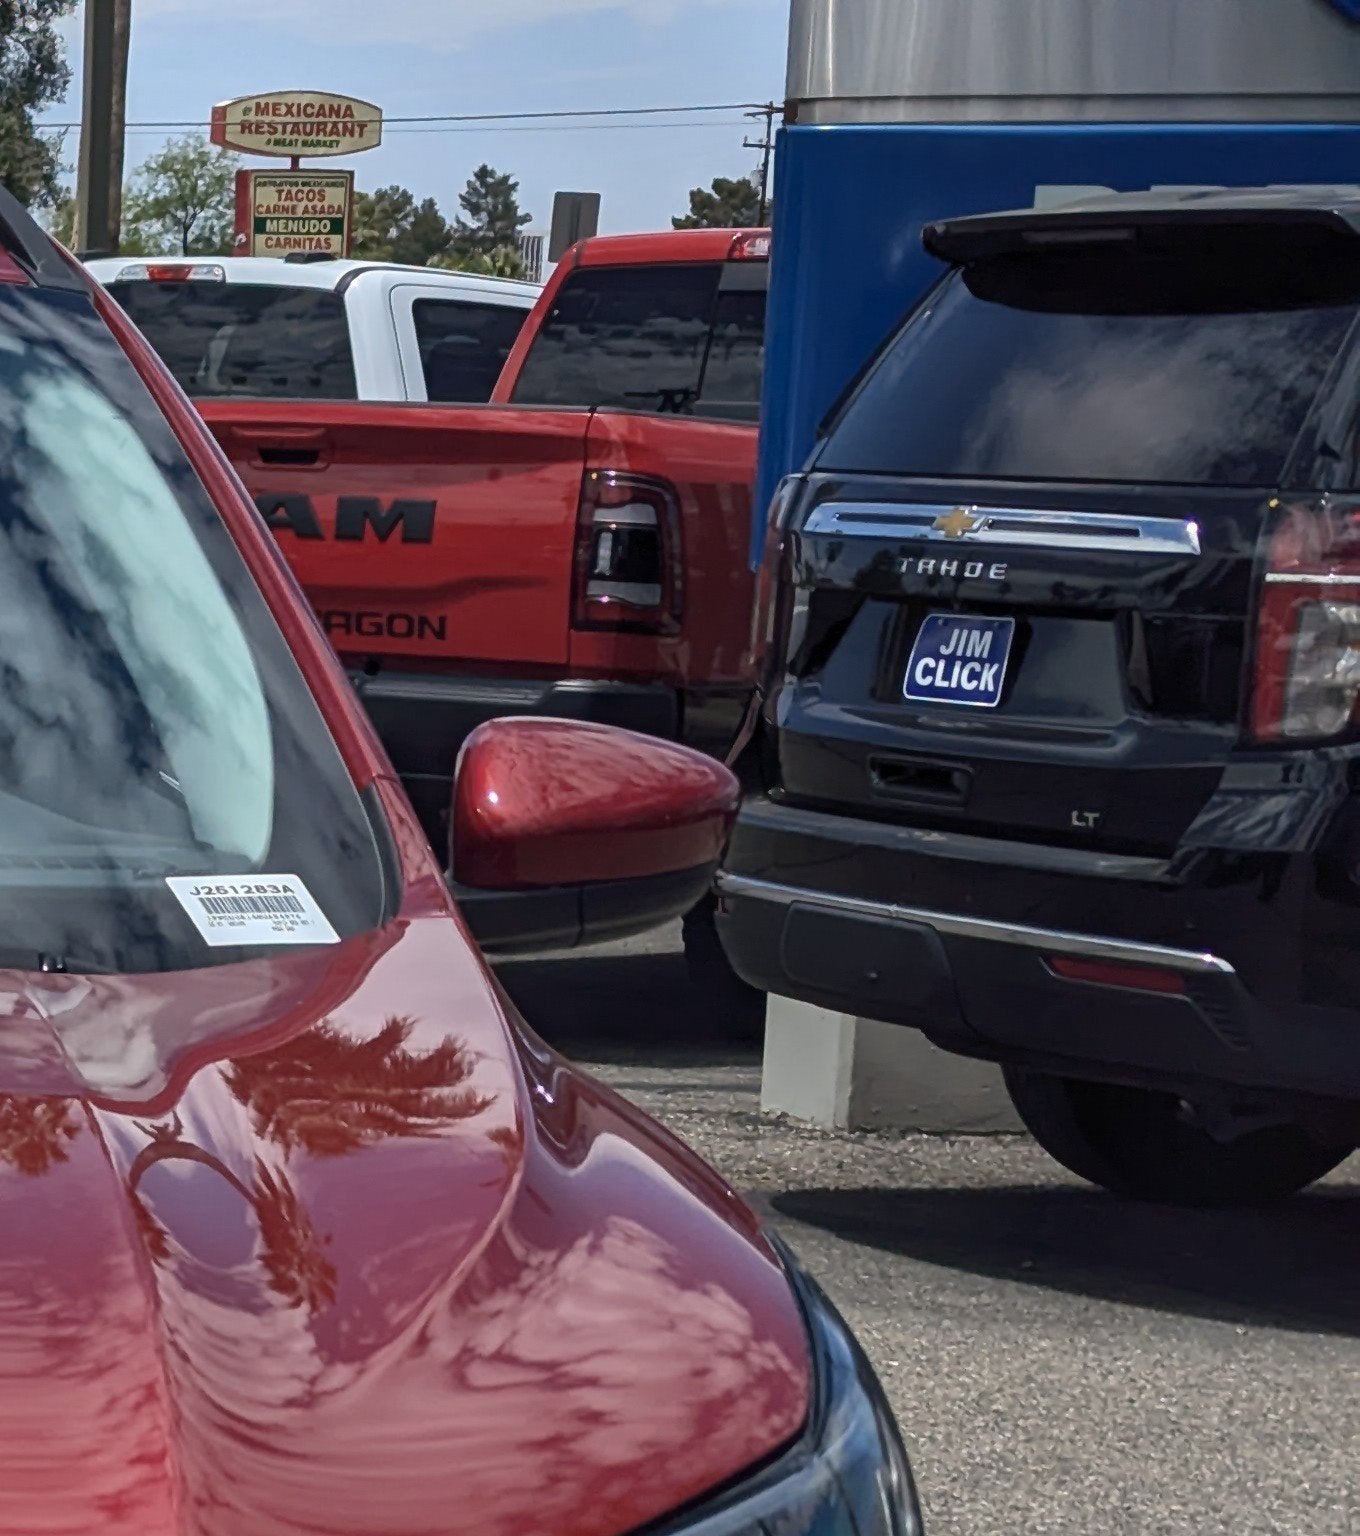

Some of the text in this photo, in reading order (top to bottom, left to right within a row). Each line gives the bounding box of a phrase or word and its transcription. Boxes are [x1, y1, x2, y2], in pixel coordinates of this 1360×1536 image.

[254, 101, 355, 119] MEXICANA
[239, 120, 368, 138] RESTAURANT
[275, 188, 326, 203] TACOS
[255, 204, 344, 215] CARNE ASADA
[265, 219, 331, 233] MENUDO
[264, 236, 332, 250] CARNITAS
[255, 491, 438, 544] AM
[898, 557, 1008, 580] TAHOE
[319, 611, 448, 641] AGON
[939, 628, 994, 659] JIM
[914, 657, 1000, 692] CLICK
[1072, 810, 1100, 828] LT
